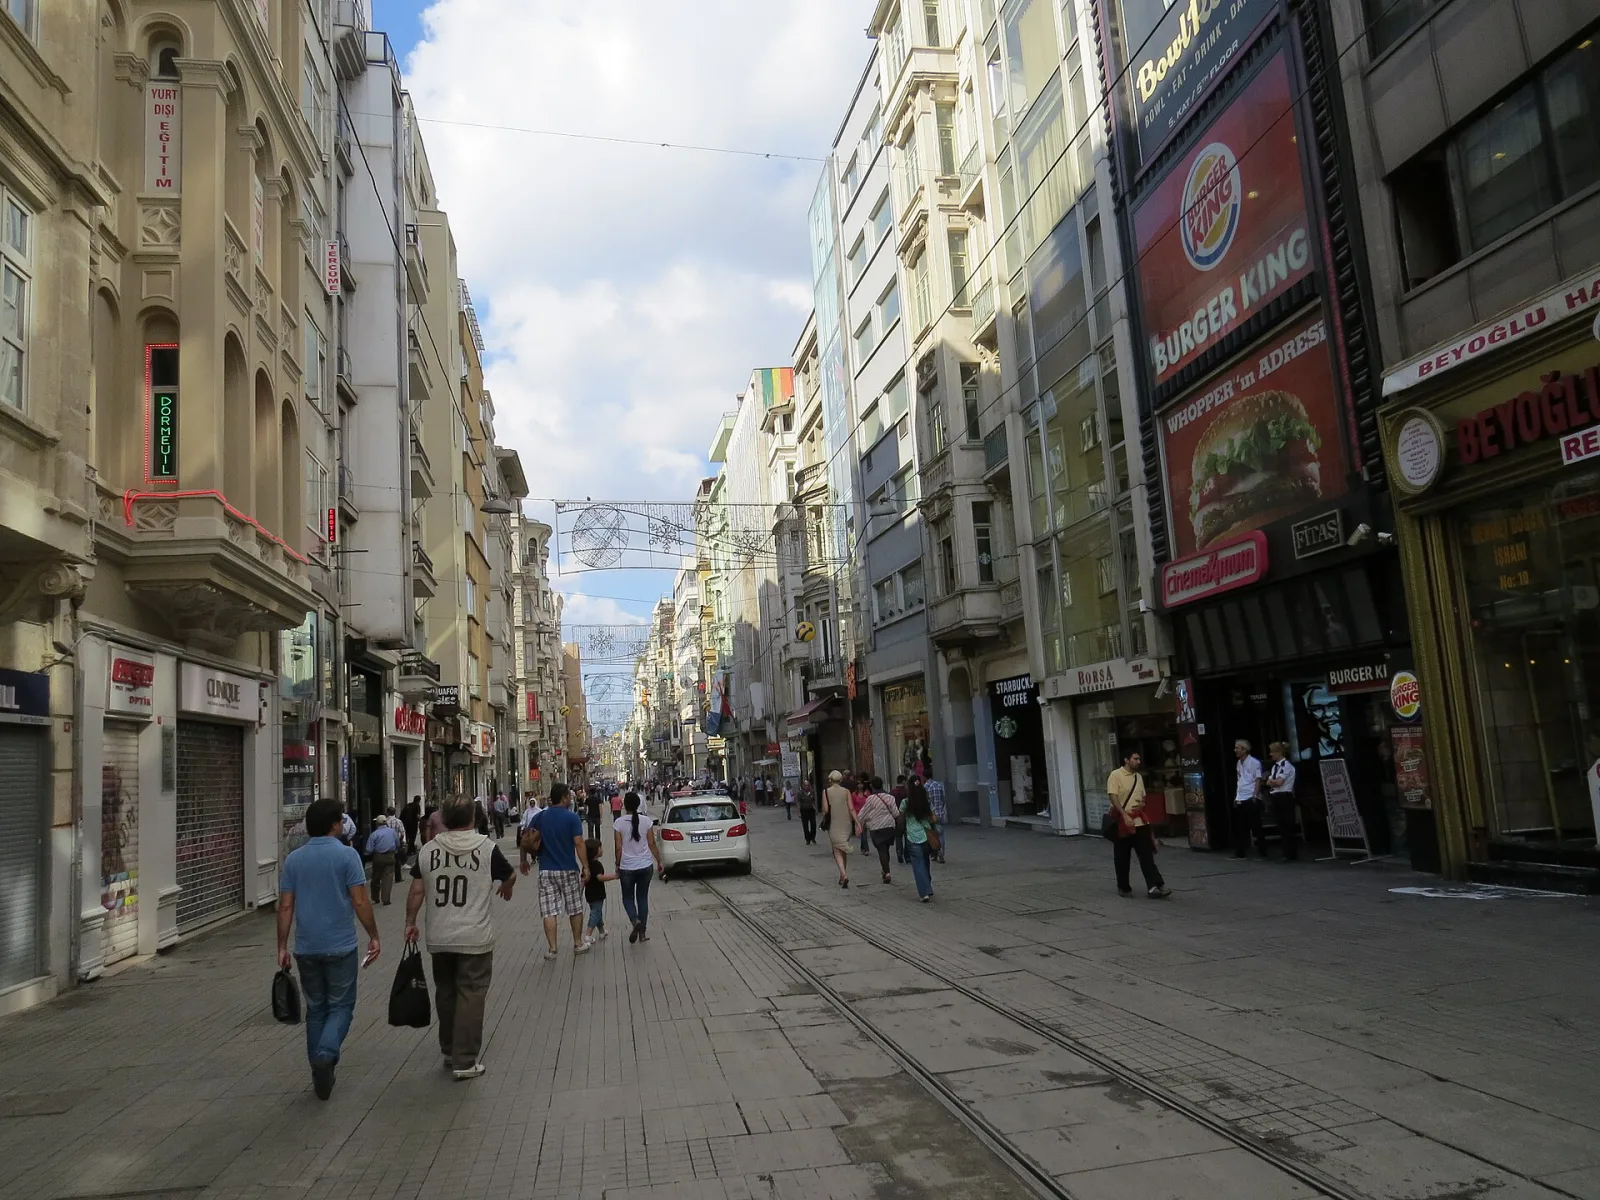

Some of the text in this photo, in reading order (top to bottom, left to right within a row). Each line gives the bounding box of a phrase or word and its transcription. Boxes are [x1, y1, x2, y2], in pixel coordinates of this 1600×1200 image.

[1144, 96, 1166, 129] BOWL
[1172, 66, 1188, 94] EAT
[1194, 22, 1222, 66] DRINK
[1176, 97, 1191, 119] KAT
[1209, 39, 1239, 79] FLOOR
[151, 88, 178, 101] YURT
[154, 104, 174, 118] DIŞI
[156, 121, 172, 188] EĞİTİM
[1187, 154, 1227, 227] BURGER
[1191, 178, 1233, 252] KING
[1154, 228, 1308, 376] BURGER KING
[1418, 307, 1546, 378] BEYOĞLU
[160, 396, 172, 475] DORMEUIL
[1295, 519, 1339, 549] FİTAŞ
[1166, 547, 1256, 596] cinemaximum
[996, 675, 1034, 695] STARBUCKS
[1077, 665, 1114, 686] BORSA
[1329, 665, 1374, 686] BURGER
[1391, 681, 1417, 698] BURGER
[1003, 691, 1029, 708] COFFEE
[1391, 690, 1420, 710] KING
[434, 874, 469, 908] 90
